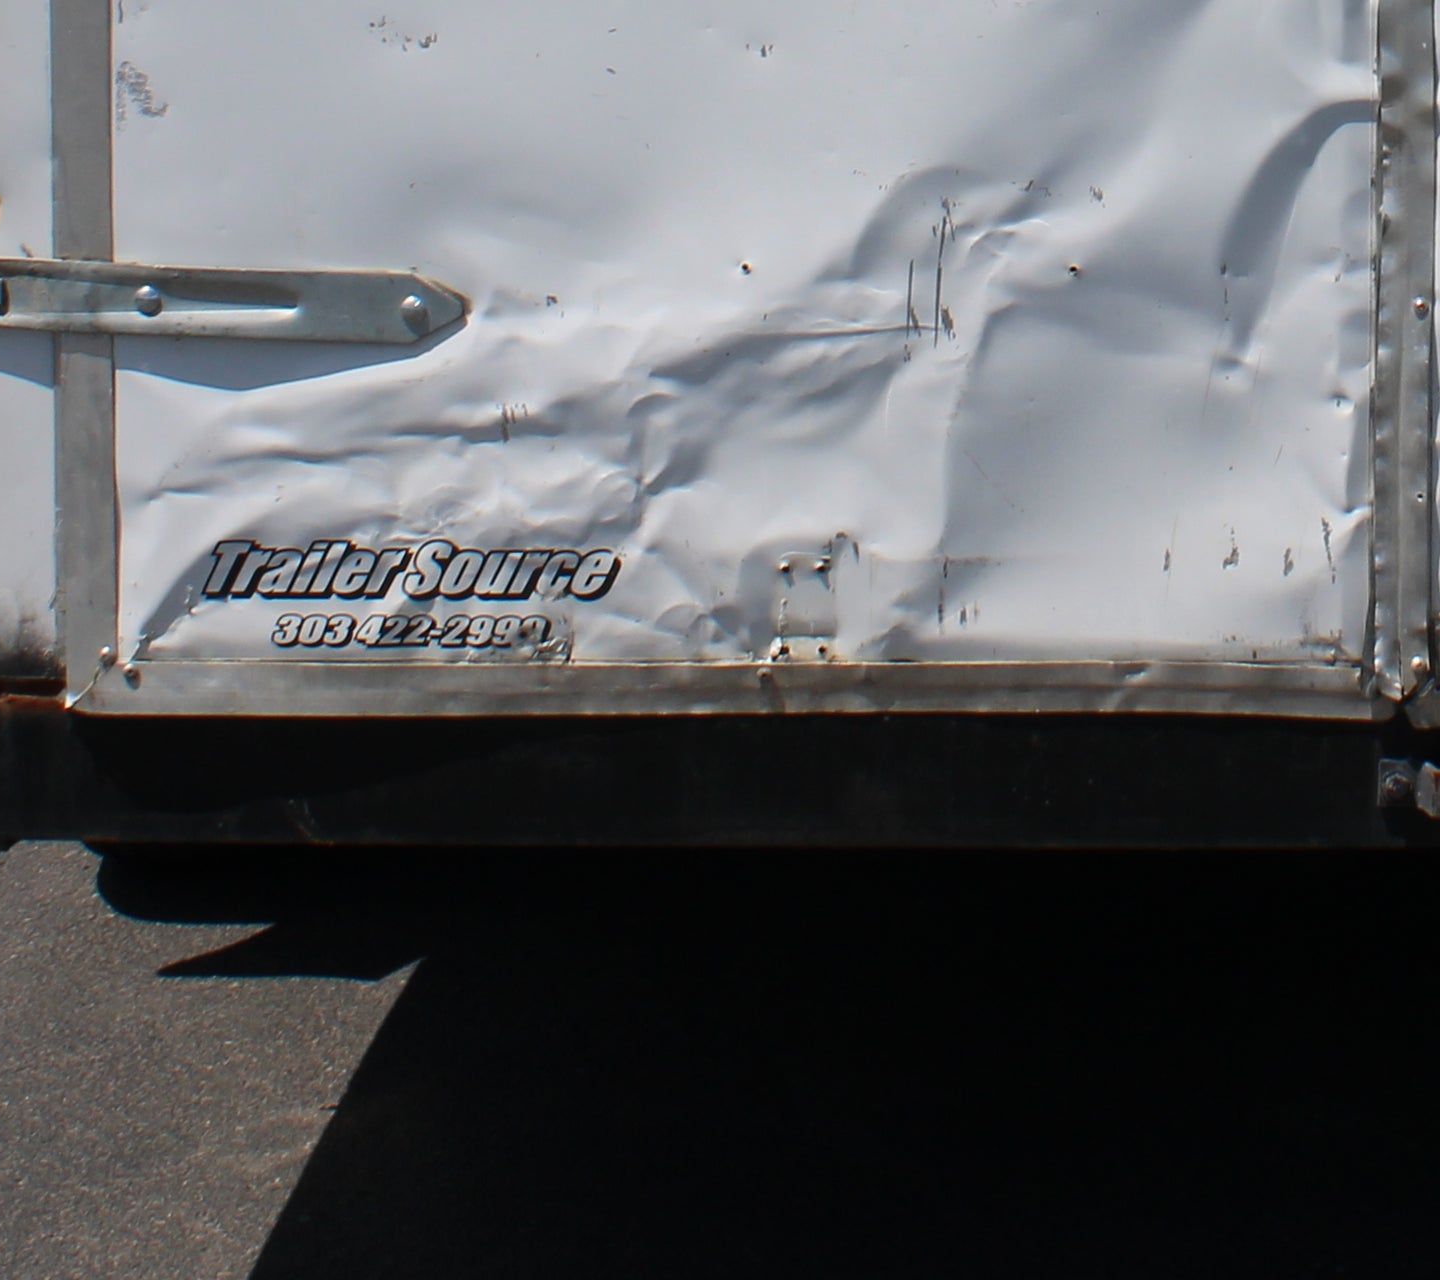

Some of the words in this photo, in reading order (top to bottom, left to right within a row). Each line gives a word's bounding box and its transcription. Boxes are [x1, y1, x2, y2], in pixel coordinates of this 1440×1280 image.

[201, 539, 411, 600] Trailer
[402, 539, 621, 601] Source
[271, 613, 357, 648] 303
